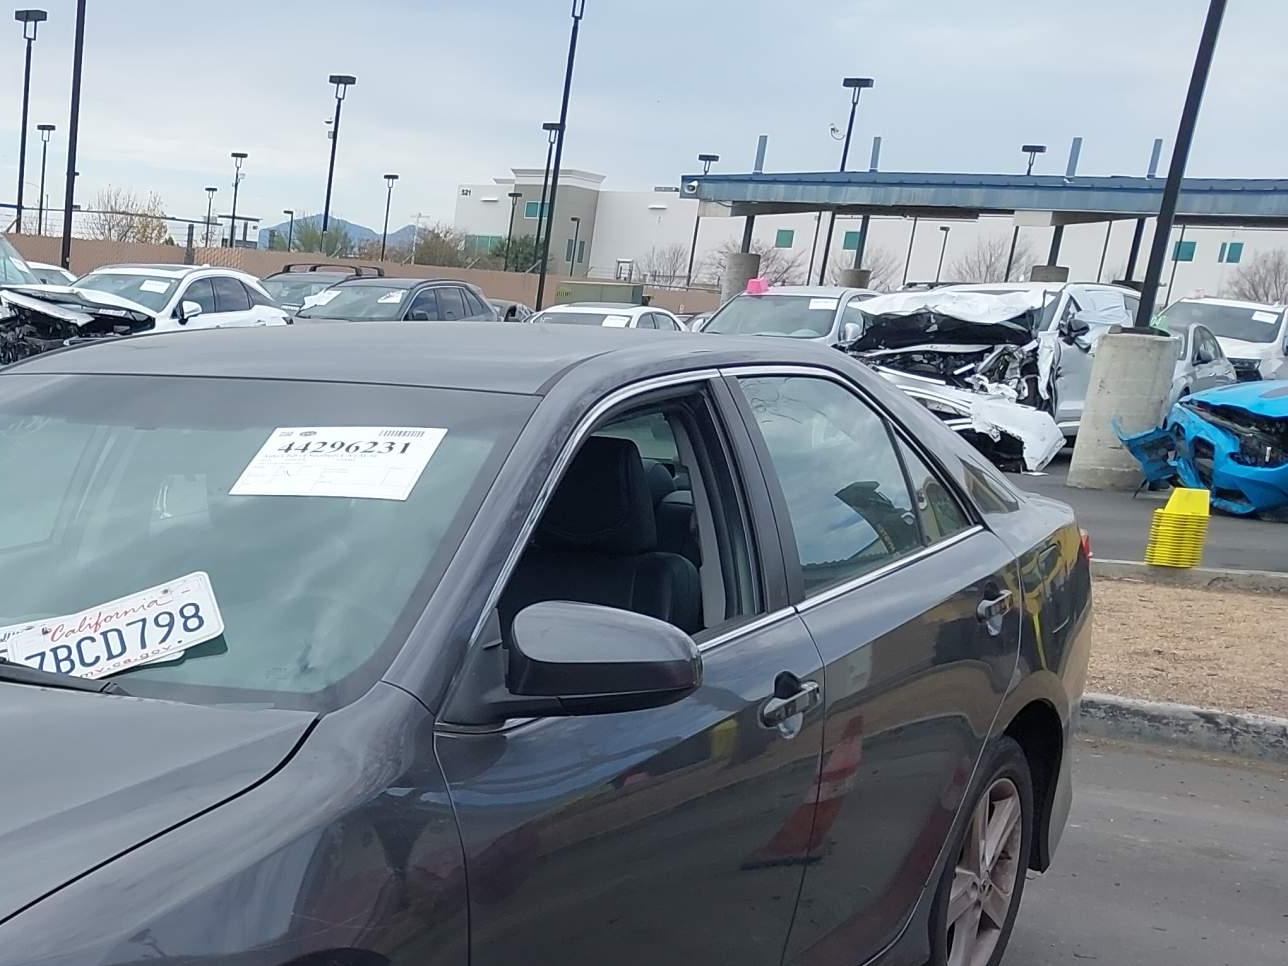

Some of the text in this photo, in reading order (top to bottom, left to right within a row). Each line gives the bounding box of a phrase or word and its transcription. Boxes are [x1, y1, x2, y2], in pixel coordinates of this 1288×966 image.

[277, 440, 412, 455] 44296231
[24, 602, 205, 676] 7BCD798
[50, 595, 174, 643] California
